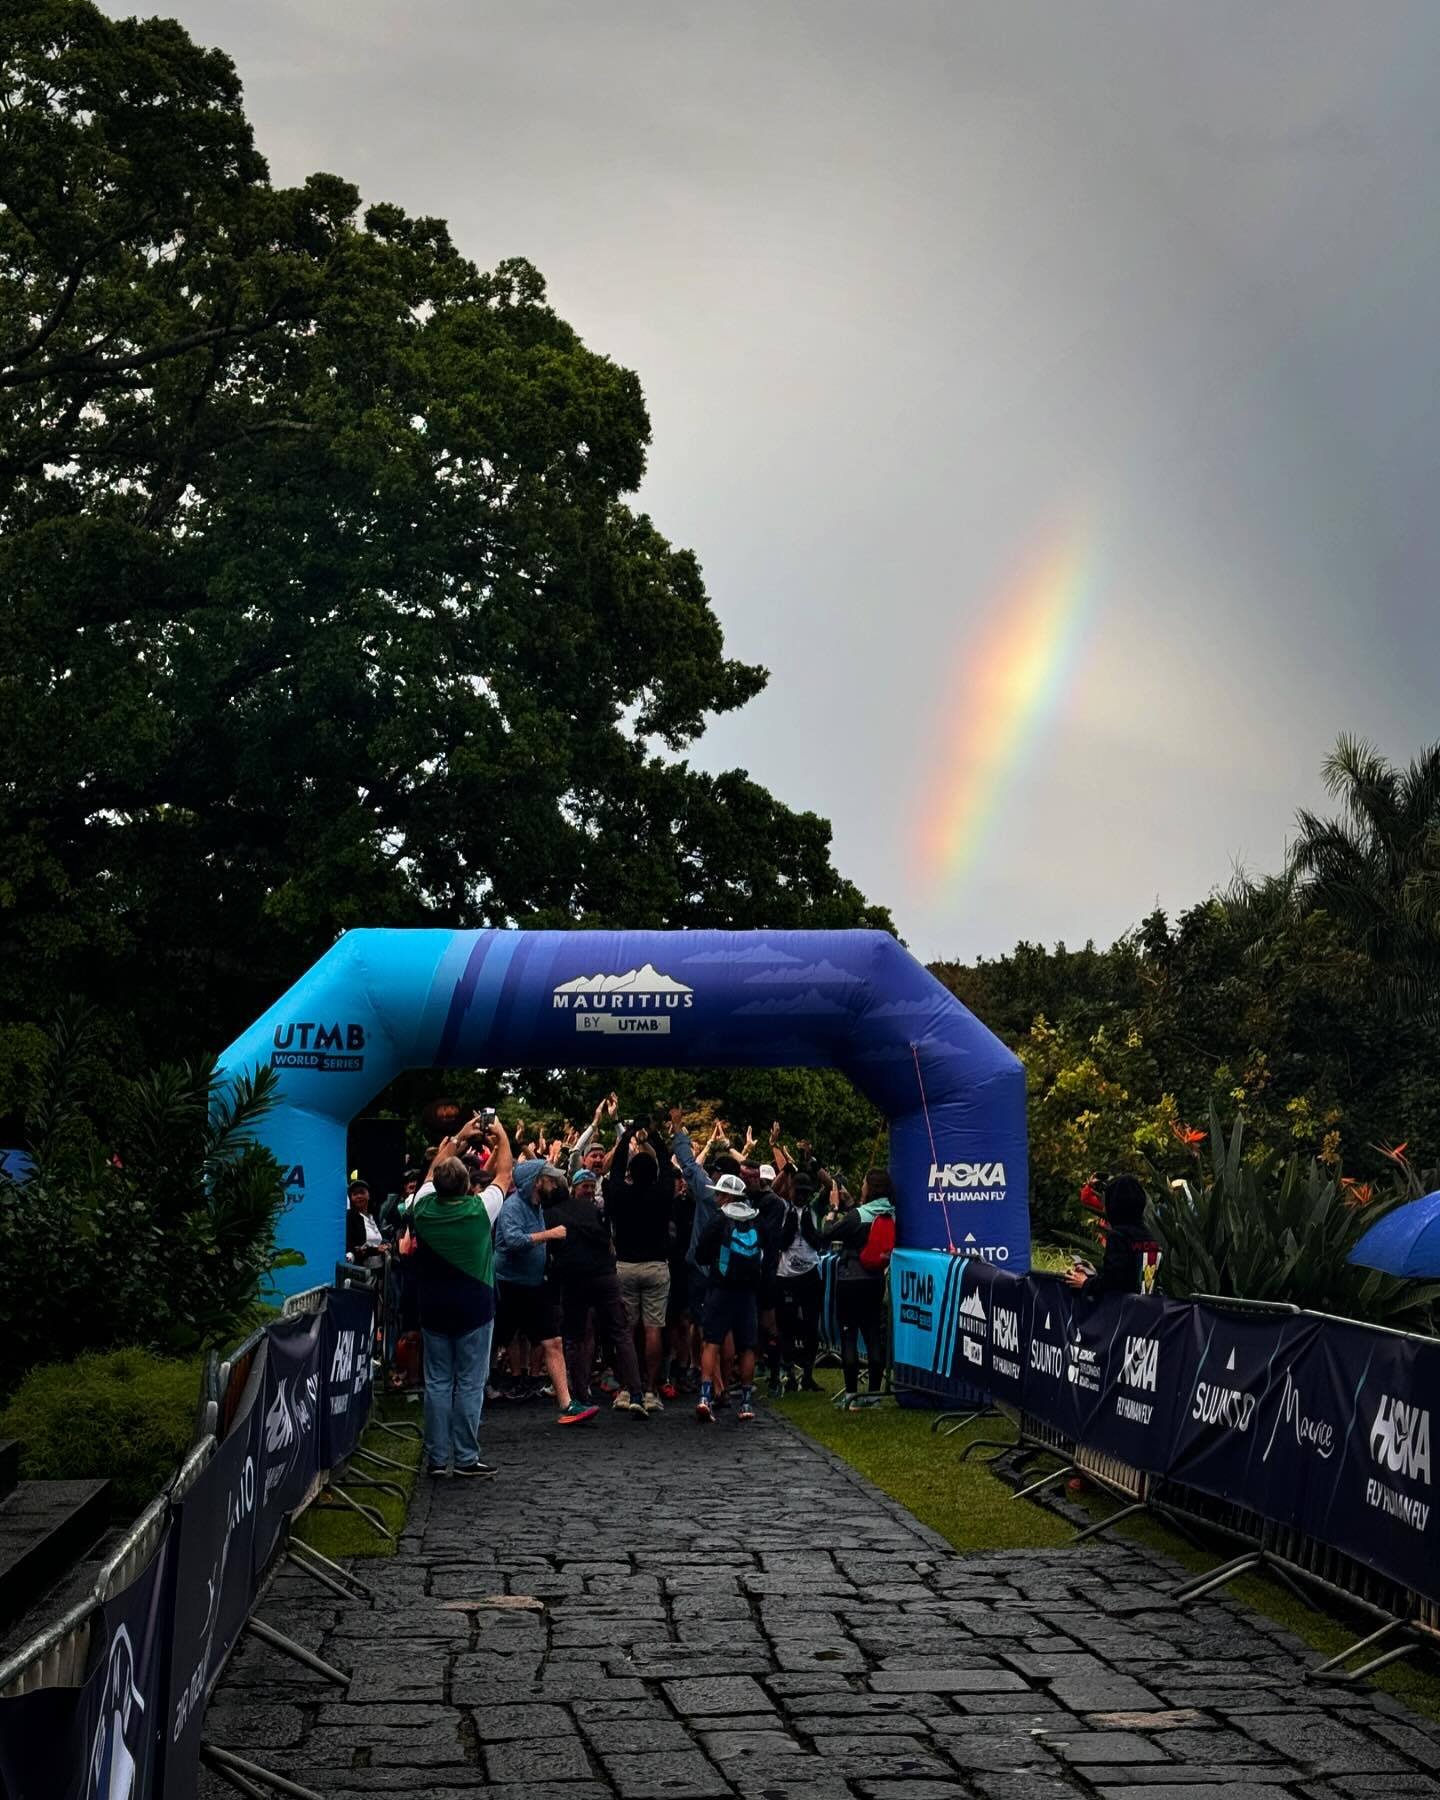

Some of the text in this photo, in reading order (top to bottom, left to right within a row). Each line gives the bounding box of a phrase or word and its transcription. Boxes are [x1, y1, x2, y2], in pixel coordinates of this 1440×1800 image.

[553, 994, 694, 1008] MAURITIUS
[274, 1022, 366, 1050] UTMB
[584, 1017, 659, 1031] BY UTMB
[274, 1054, 360, 1069] WORLD SERIES
[928, 1162, 1006, 1187] HOKA
[928, 1190, 1007, 1202] FLY HUMAN FLY
[901, 1269, 934, 1305] UTMB
[993, 1305, 1019, 1354] HOKA
[1030, 1338, 1063, 1380] SUUNTO
[1193, 1381, 1256, 1432] SUUNTO
[1369, 1393, 1432, 1486] HOKA
[1366, 1478, 1383, 1507] FLY
[1411, 1500, 1430, 1532] FLY
